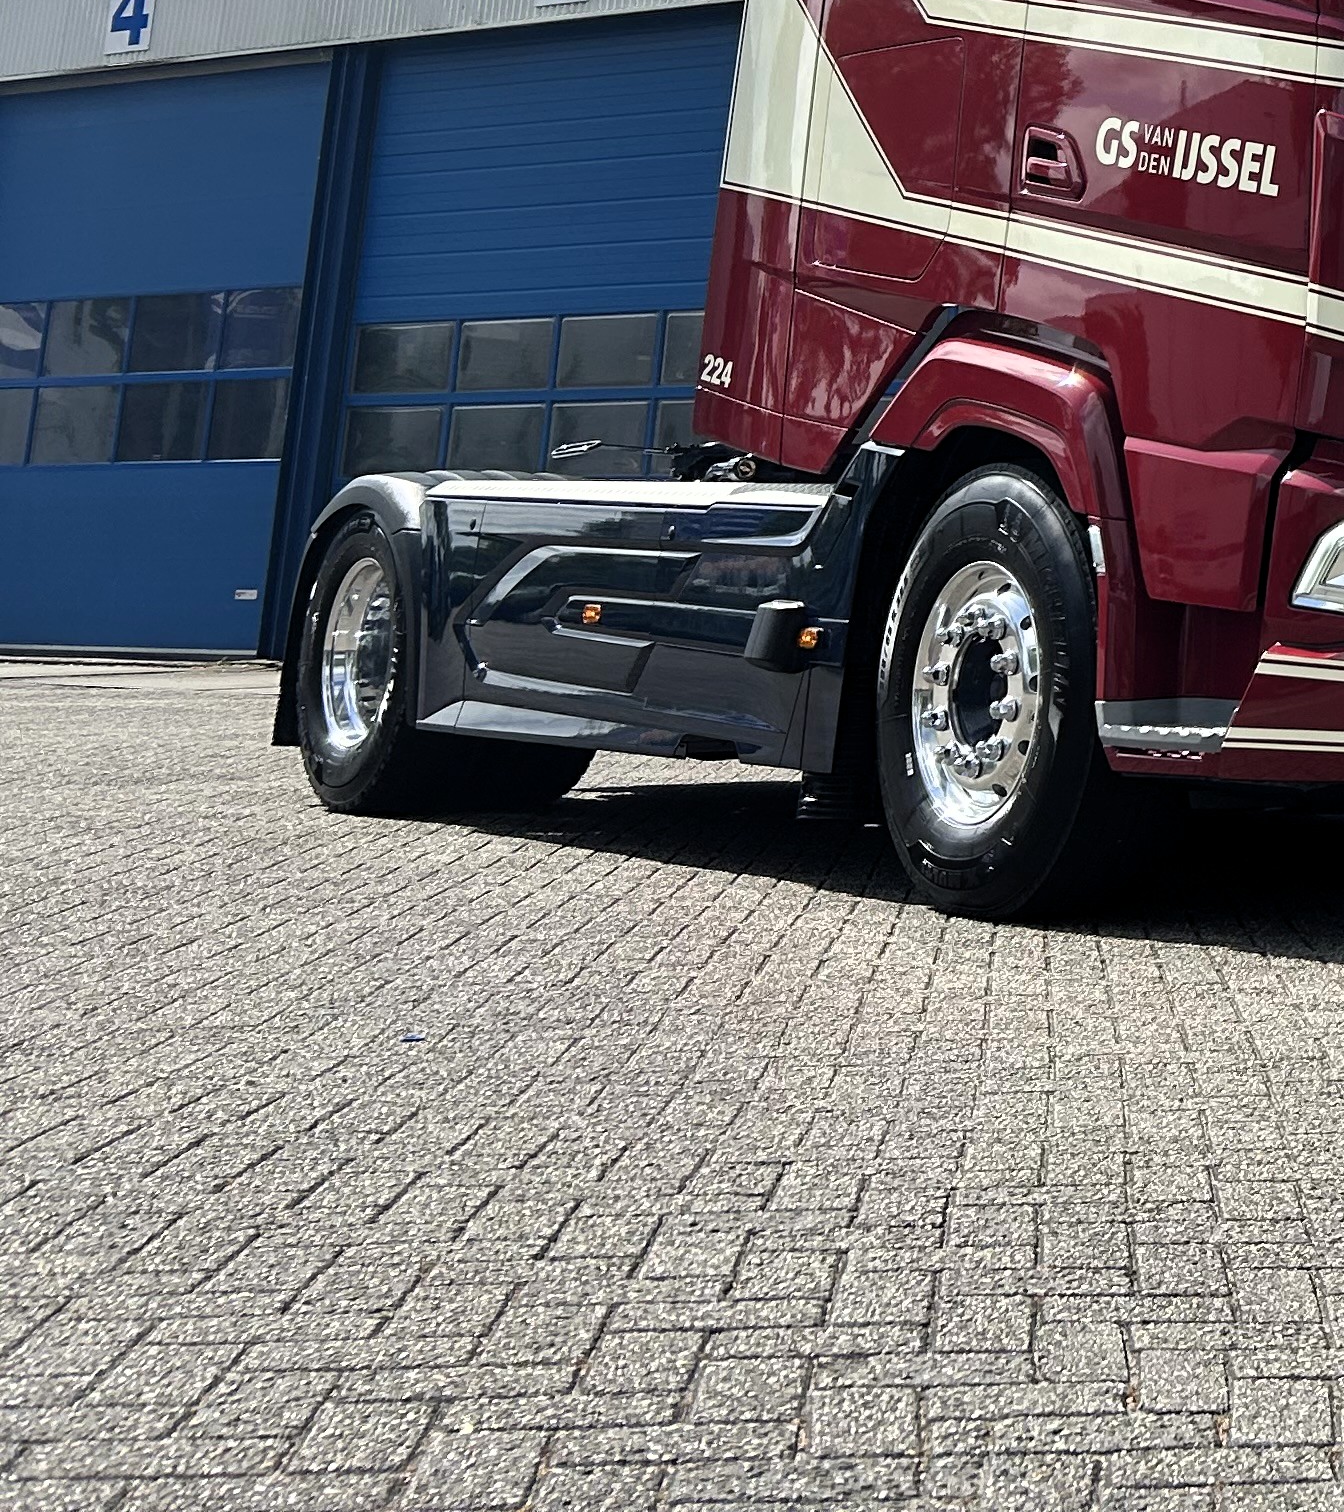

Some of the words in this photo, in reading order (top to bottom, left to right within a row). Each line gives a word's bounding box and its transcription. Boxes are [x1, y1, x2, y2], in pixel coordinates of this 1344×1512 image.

[1095, 116, 1141, 169] GS
[1143, 123, 1175, 149] VAN
[1137, 151, 1171, 177] DEN
[1172, 129, 1280, 197] IJSSEL
[700, 353, 734, 389] 224
